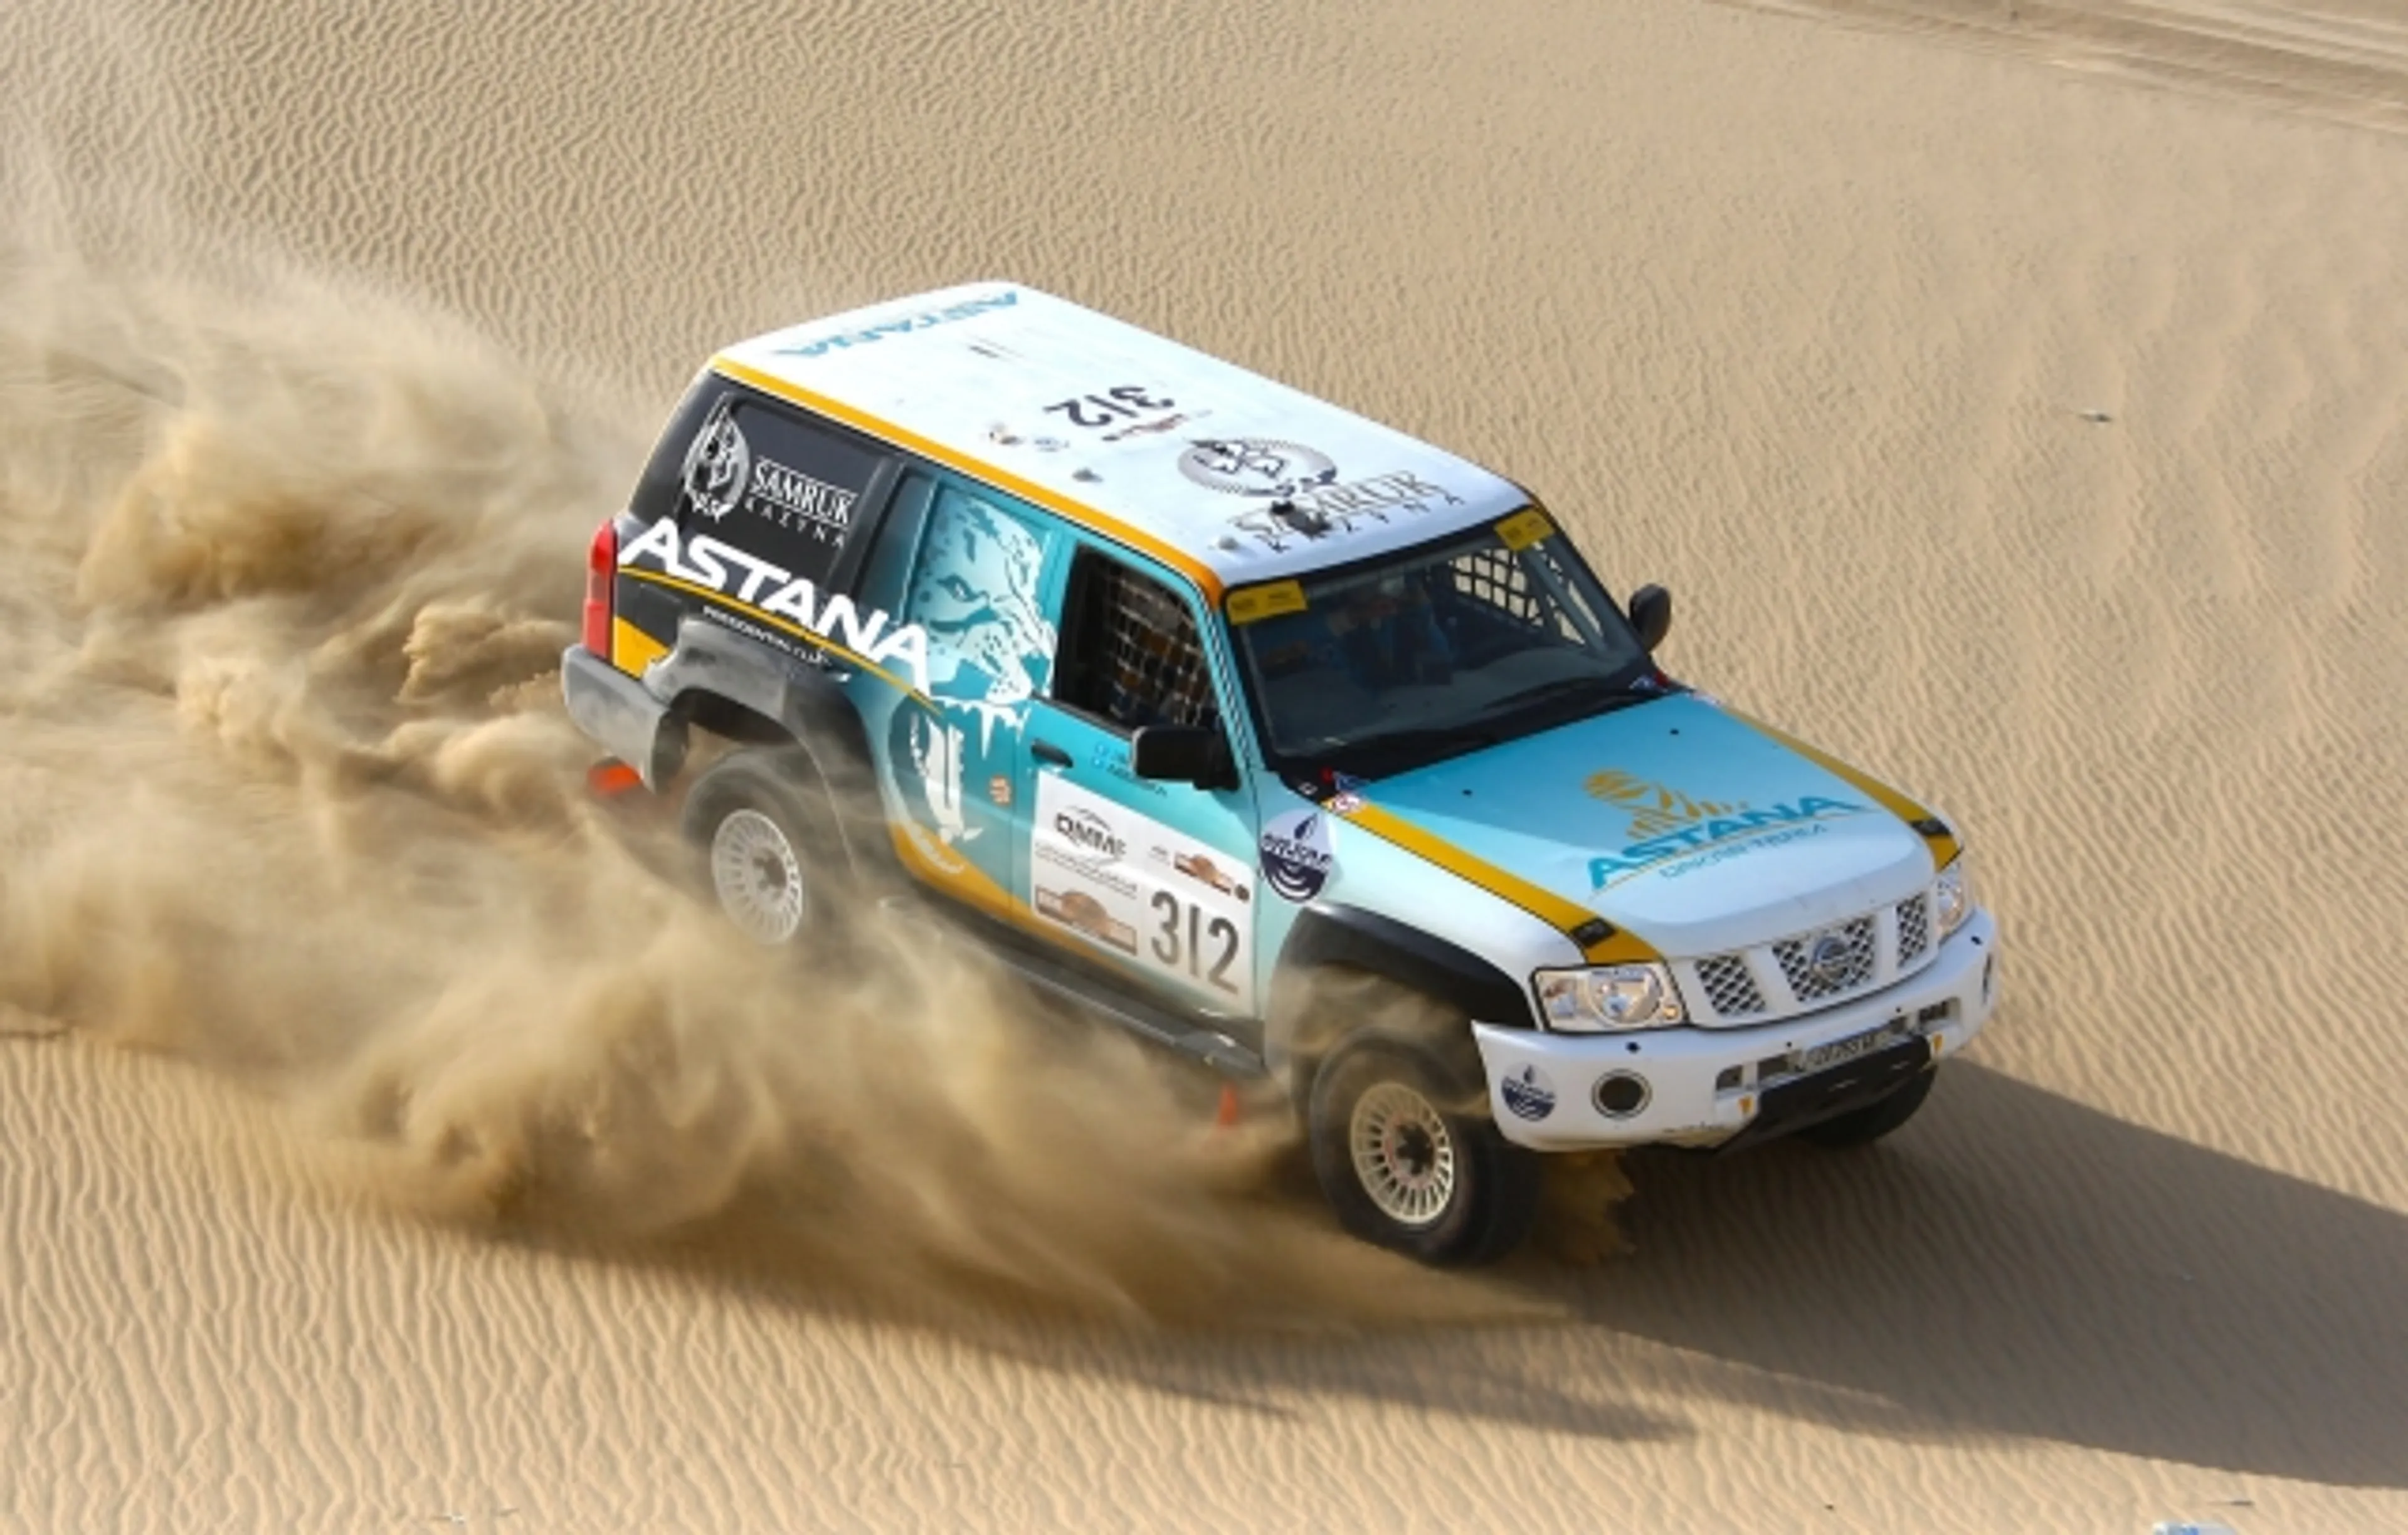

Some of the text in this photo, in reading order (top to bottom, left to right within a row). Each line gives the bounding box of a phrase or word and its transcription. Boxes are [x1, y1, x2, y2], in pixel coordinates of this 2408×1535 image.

[1042, 384, 1175, 428] 312
[752, 458, 855, 525] SAMRUK
[1229, 470, 1436, 538] SRUK
[617, 517, 931, 697] ASTANA
[1587, 795, 1869, 890] ASTANA
[1150, 888, 1239, 996] 312
